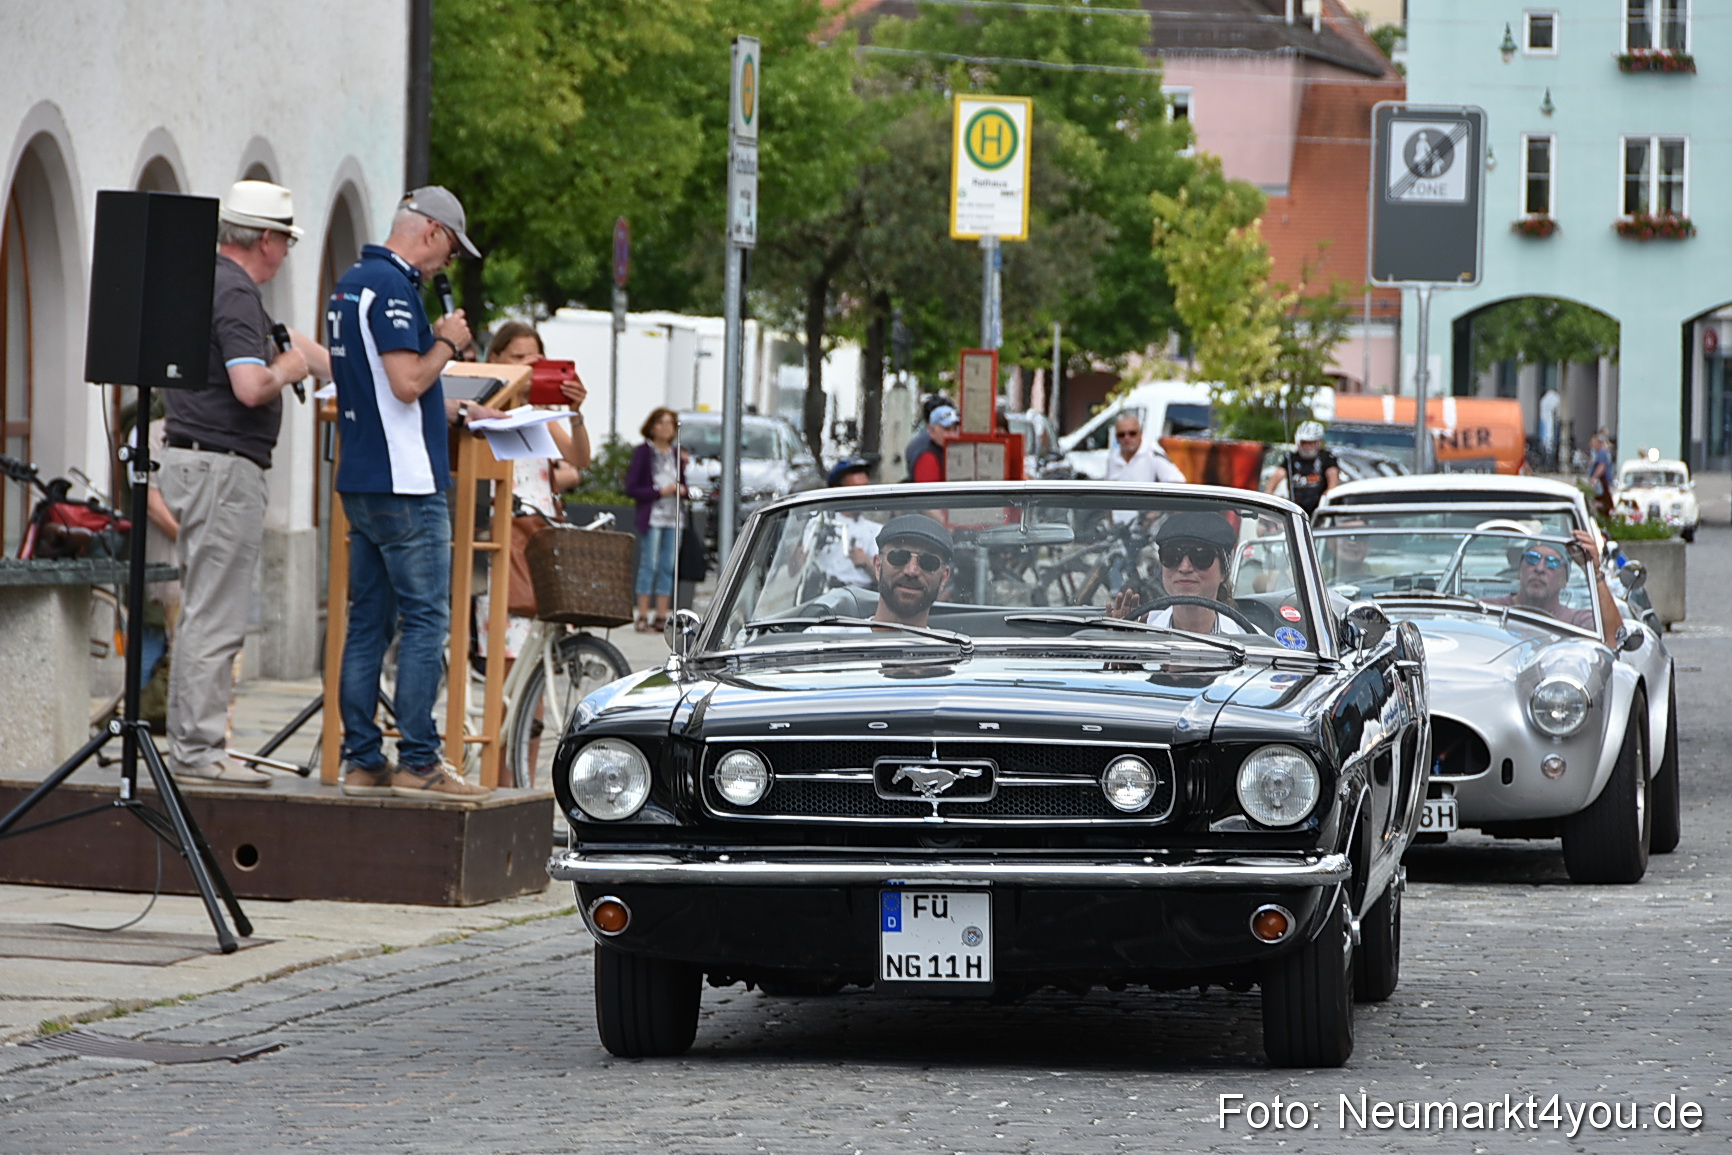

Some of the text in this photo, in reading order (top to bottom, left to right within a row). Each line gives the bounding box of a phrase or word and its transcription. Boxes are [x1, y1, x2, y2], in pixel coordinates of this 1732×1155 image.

[981, 122, 1002, 155] H
[1407, 182, 1448, 196] ZONE
[768, 721, 1103, 733] FORD
[913, 894, 948, 918] FÜ
[887, 916, 897, 928] D
[886, 954, 921, 978] NG
